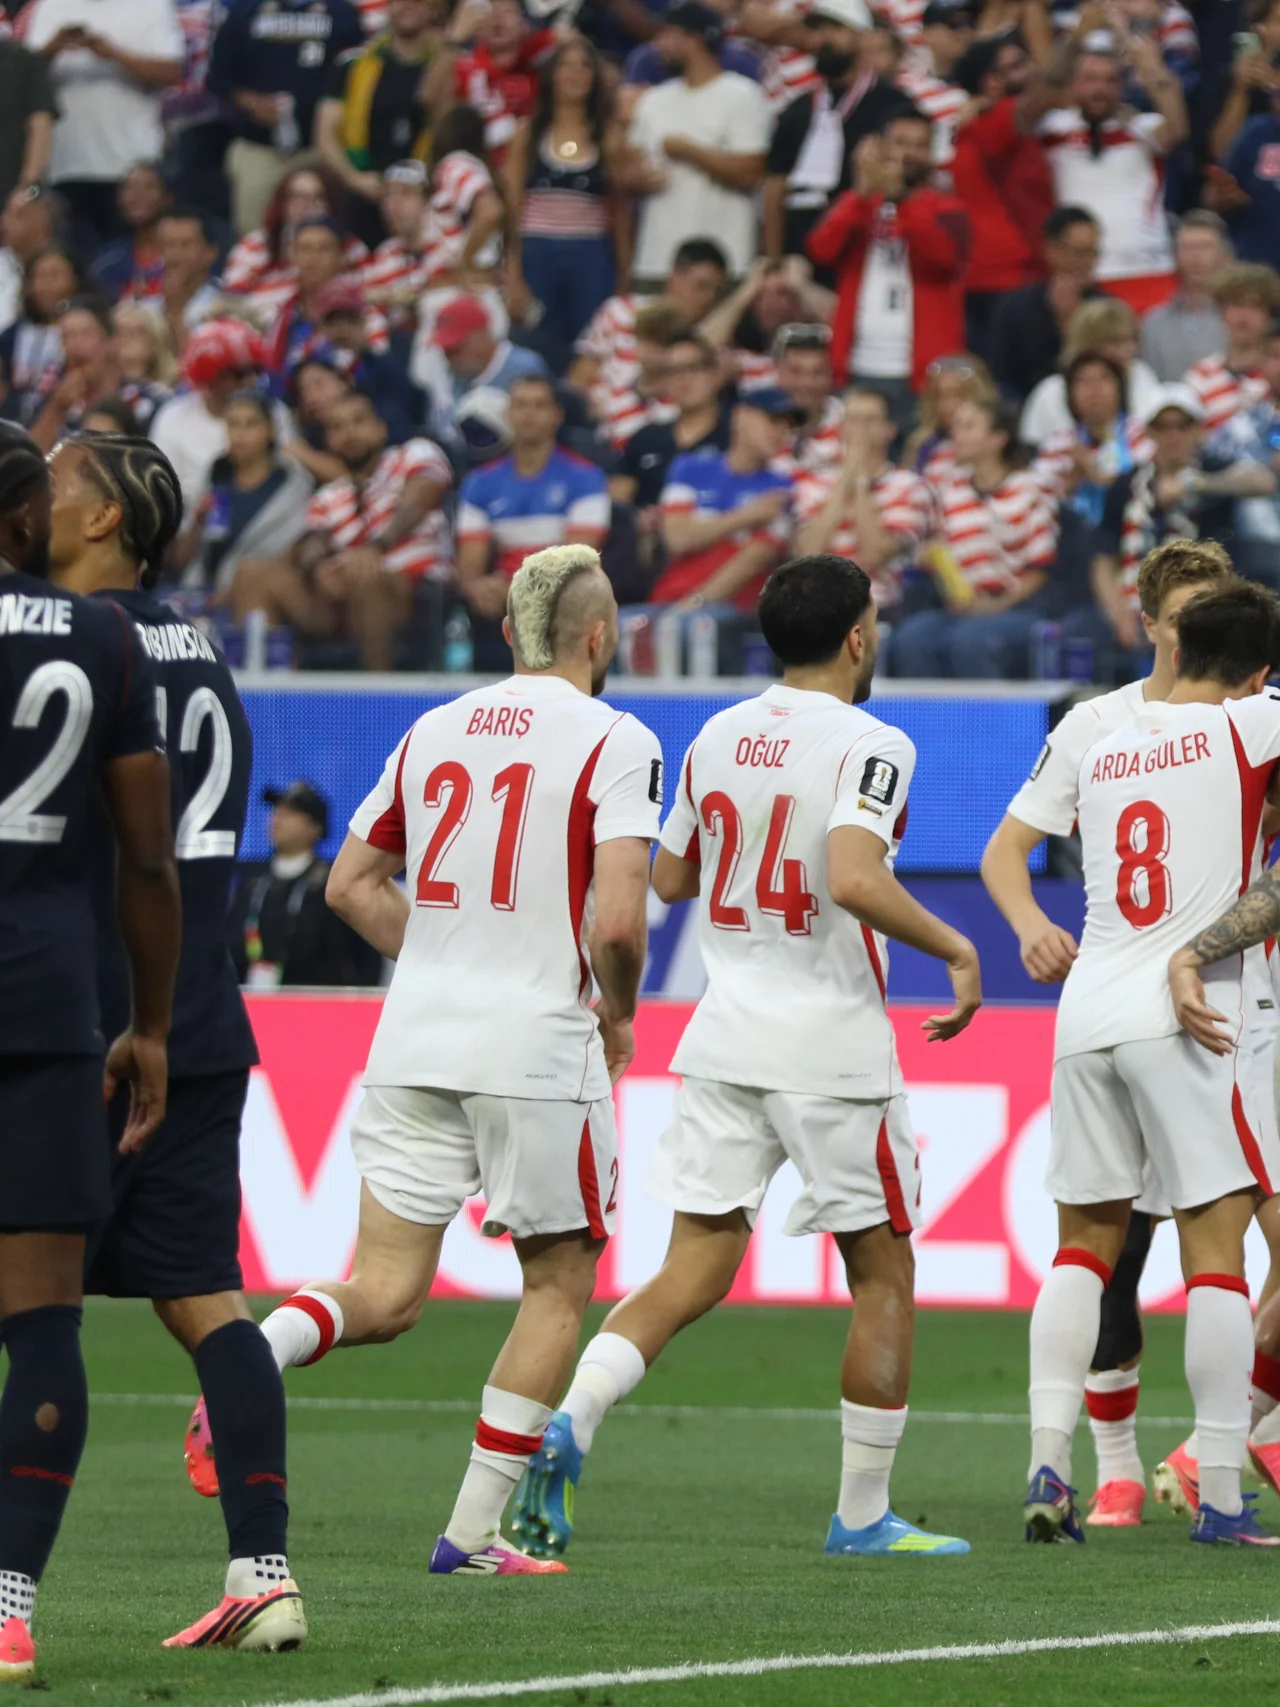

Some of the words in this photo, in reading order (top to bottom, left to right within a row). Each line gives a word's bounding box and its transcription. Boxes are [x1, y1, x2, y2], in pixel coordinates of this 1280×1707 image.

[0, 593, 72, 634] NZIE
[466, 707, 533, 738] BARIŞ
[735, 733, 790, 768] OĞUZ
[1091, 751, 1140, 784] ARDA
[1144, 731, 1212, 774] GÜLER
[416, 761, 535, 911] 21
[700, 791, 819, 936] 24
[1115, 800, 1172, 930] 8
